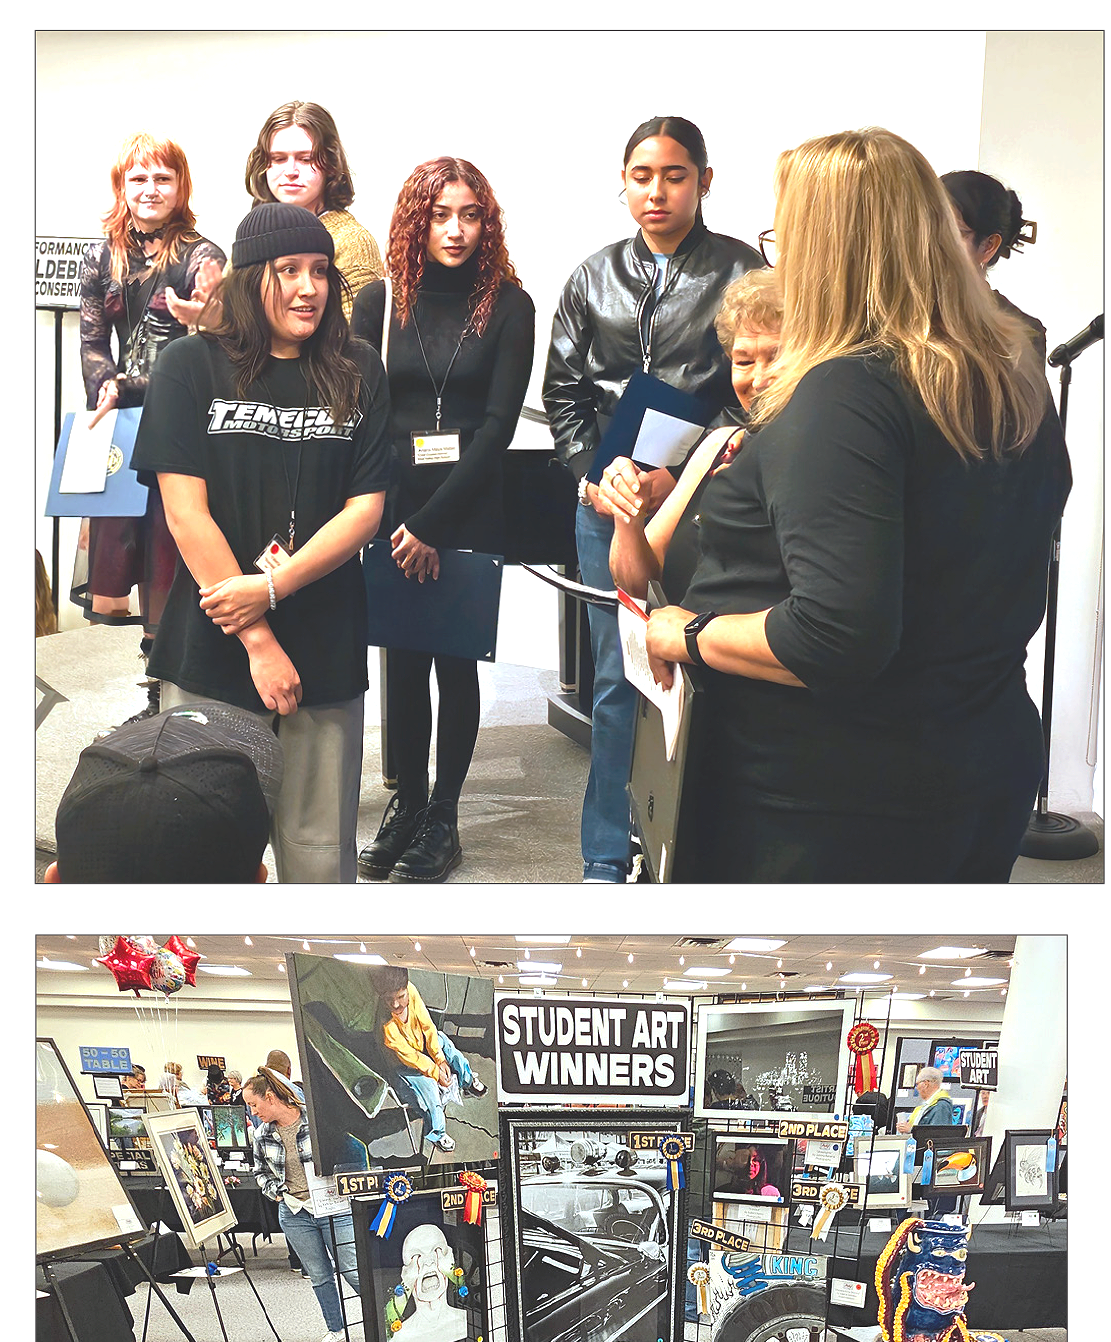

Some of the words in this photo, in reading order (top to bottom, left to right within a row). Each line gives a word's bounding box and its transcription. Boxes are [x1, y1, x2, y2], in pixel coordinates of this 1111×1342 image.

[36, 242, 91, 255] FORMANC
[36, 259, 83, 279] LDEB
[36, 281, 81, 296] CONSERV
[502, 1004, 627, 1046] STUDENT
[632, 1010, 684, 1049] ART
[82, 1048, 98, 1058] 50
[111, 1049, 128, 1059] 50
[960, 1051, 998, 1069] STUDENT
[84, 1059, 129, 1070] TABLE
[198, 1056, 226, 1069] WINE
[513, 1050, 675, 1088] WINNERS
[969, 1068, 990, 1084] ART
[780, 1121, 805, 1136] 2ND
[806, 1124, 846, 1138] PLACE
[633, 1134, 655, 1149] 1ST
[340, 1176, 365, 1194] 1ST
[792, 1184, 818, 1197] 3RD
[443, 1192, 464, 1208] 2ND
[692, 1222, 715, 1237] 3RD
[715, 1230, 750, 1250] PLACE
[771, 1255, 818, 1277] KING
